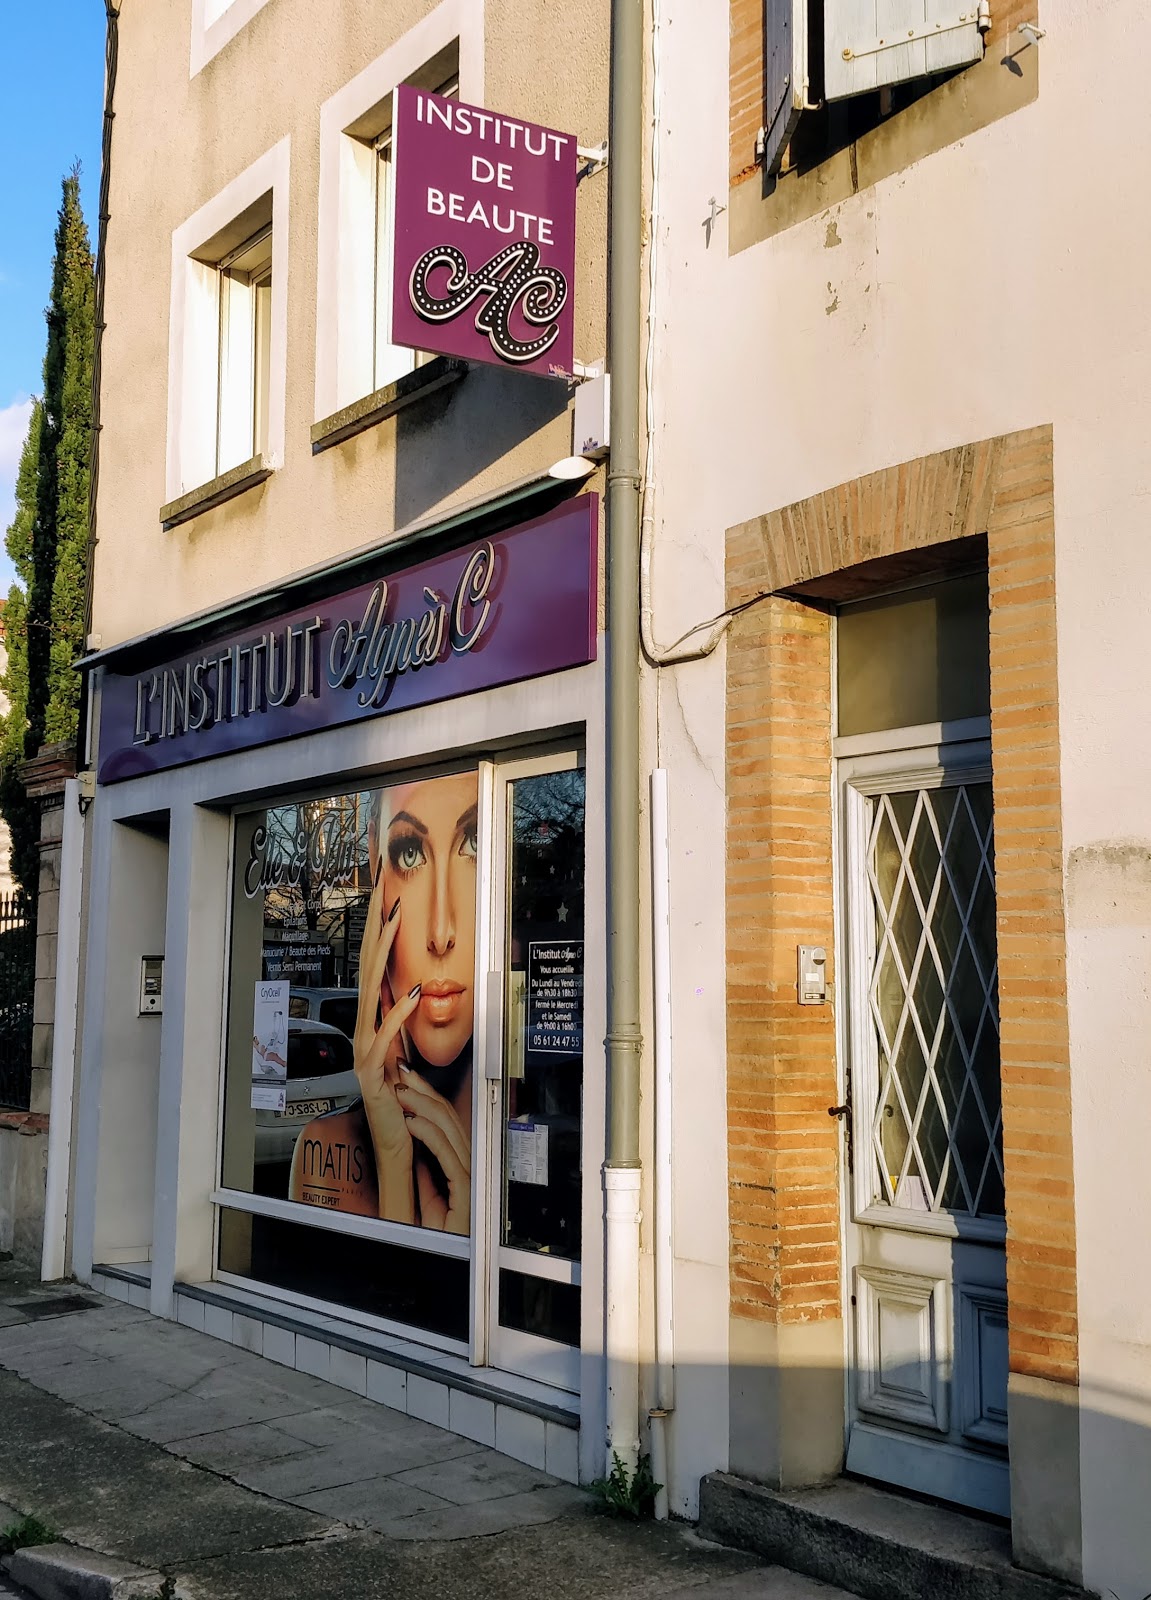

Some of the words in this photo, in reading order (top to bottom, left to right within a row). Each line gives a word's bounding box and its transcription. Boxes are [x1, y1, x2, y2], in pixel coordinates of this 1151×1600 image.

[417, 95, 568, 161] INSTITUT
[471, 155, 514, 191] DE
[427, 187, 554, 245] BEAUTE
[133, 615, 325, 745] L'INSTITUT
[449, 540, 496, 652] C
[307, 945, 316, 955] des
[317, 944, 331, 955] Pieds
[533, 949, 560, 959] L'Institut
[282, 961, 294, 971] Semi
[295, 961, 322, 971] Permanent
[540, 965, 551, 973] Vous
[552, 964, 574, 973] accueille
[532, 979, 538, 987] Du
[539, 979, 552, 987] Lundi
[561, 978, 582, 987] Vendredi
[537, 988, 543, 997] de
[551, 1000, 556, 1009] le
[557, 1000, 578, 1009] Mercredi
[542, 1012, 547, 1020] et
[548, 1012, 553, 1020] le
[554, 1012, 571, 1020] Samedi
[537, 1021, 542, 1029] de
[534, 1034, 541, 1045] 05
[543, 1035, 550, 1045] 61
[553, 1035, 560, 1046] 24
[562, 1036, 570, 1046] 47
[571, 1036, 579, 1047] 55
[303, 1139, 363, 1184] MATIS
[302, 1192, 321, 1203] BEAUTY
[321, 1195, 340, 1207] EXPERT
